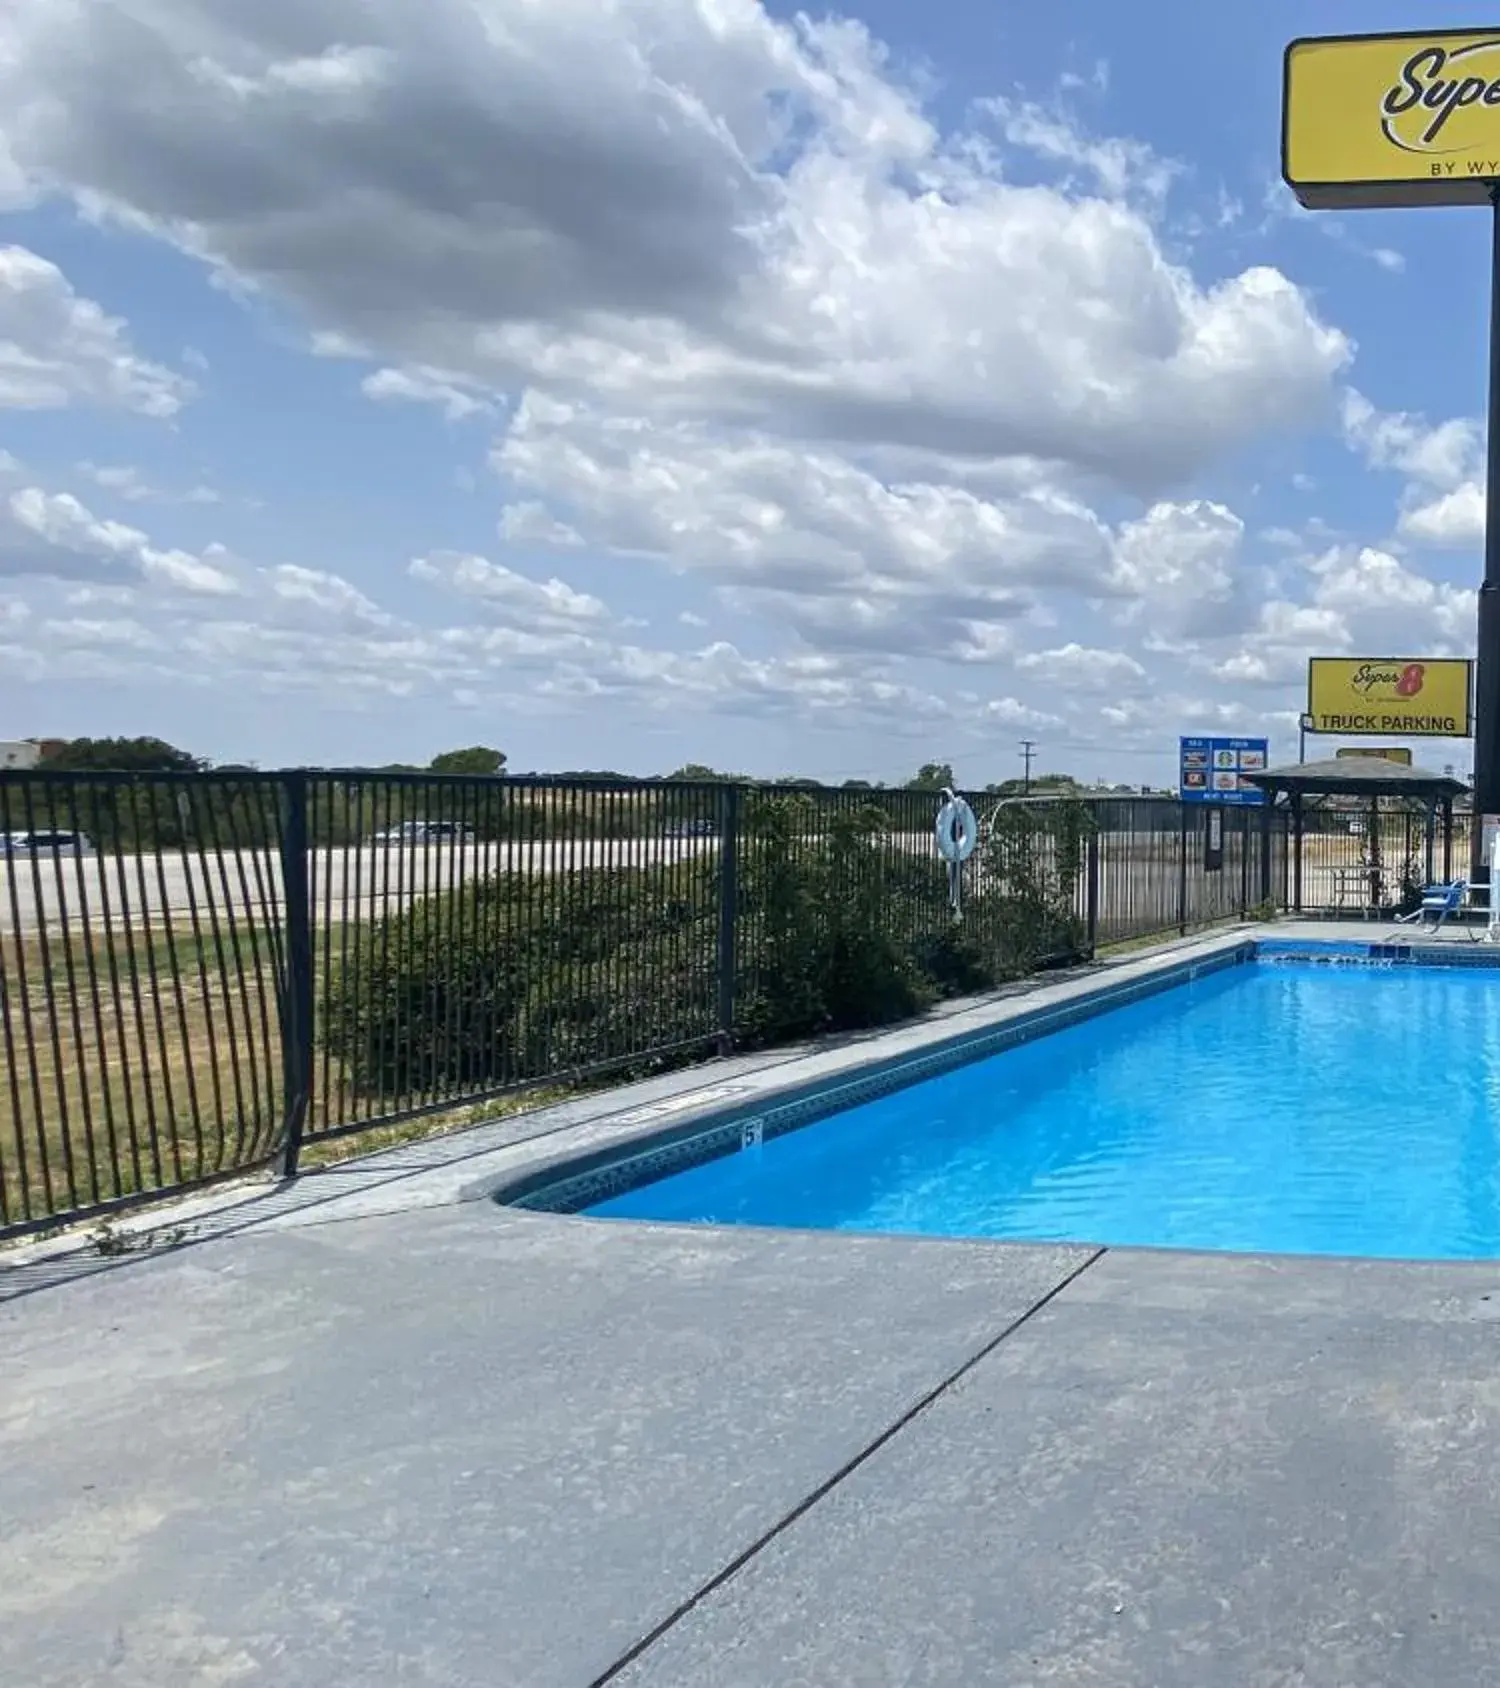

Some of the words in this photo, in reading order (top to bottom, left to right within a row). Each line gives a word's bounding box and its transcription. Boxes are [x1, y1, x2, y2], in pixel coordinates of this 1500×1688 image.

[1431, 162, 1455, 176] BY
[1353, 663, 1399, 692] Super
[1395, 663, 1425, 697] 8
[1321, 714, 1377, 729] TRUCK
[1381, 715, 1456, 731] PARKING
